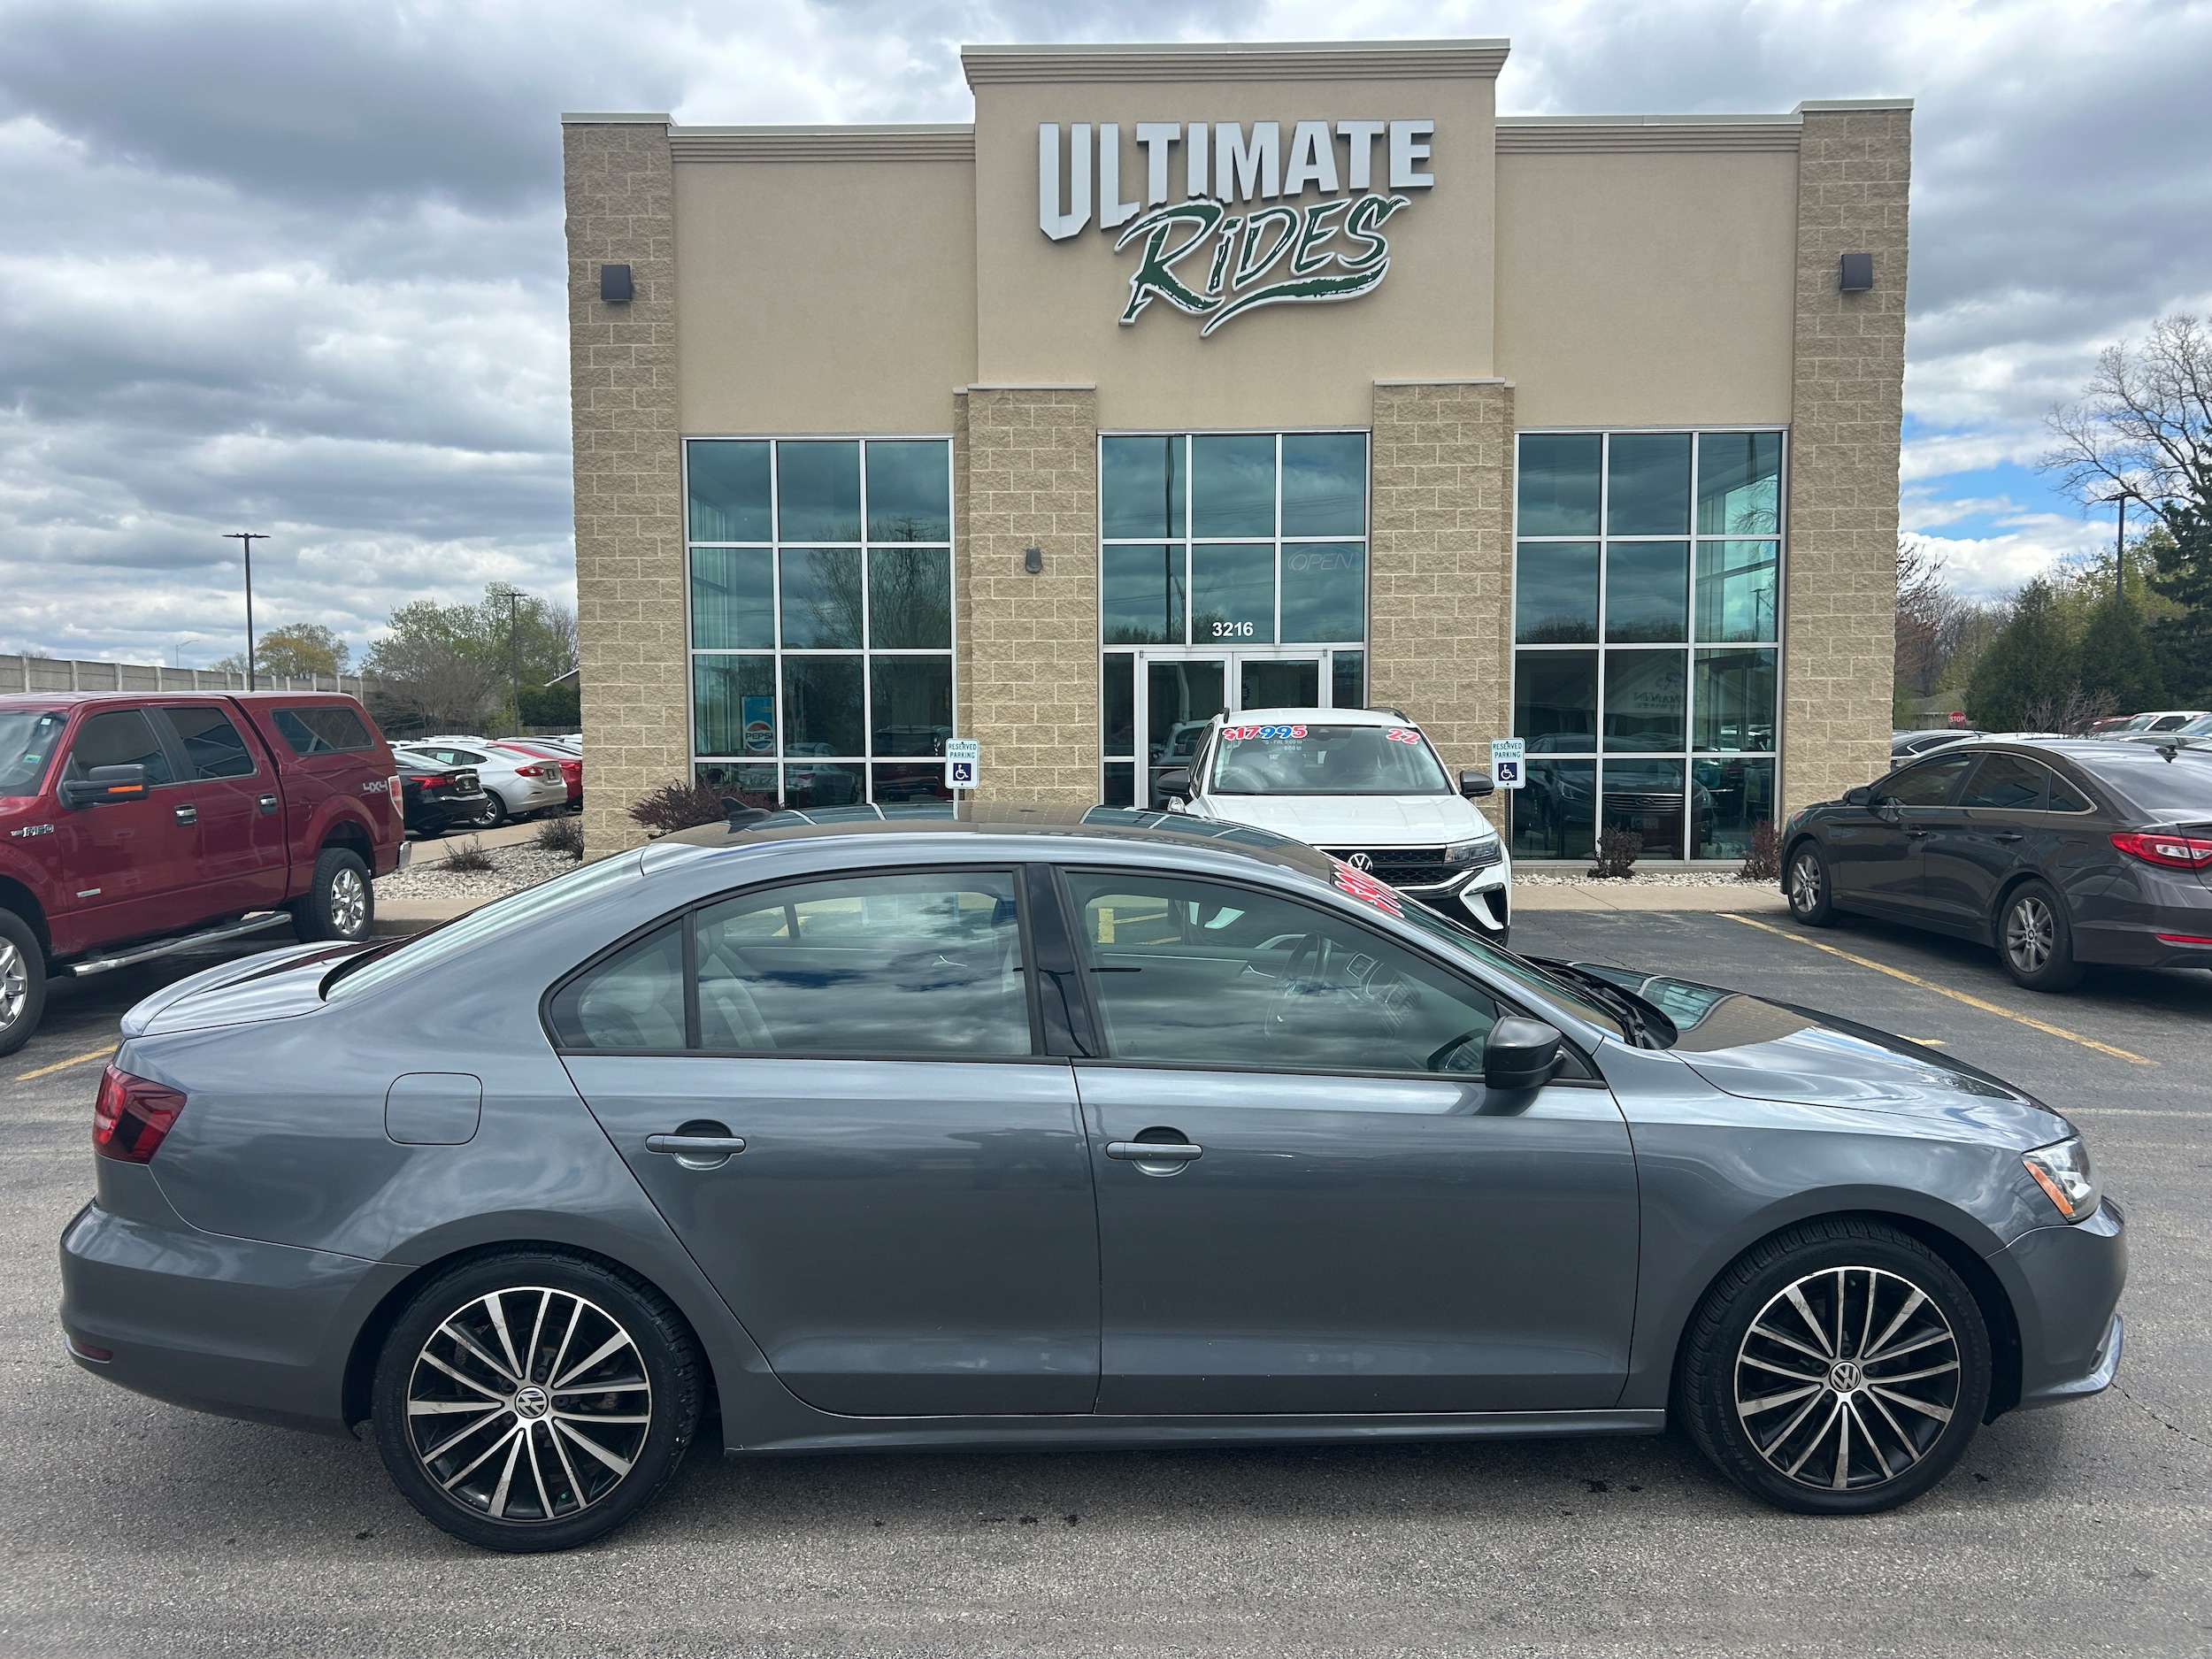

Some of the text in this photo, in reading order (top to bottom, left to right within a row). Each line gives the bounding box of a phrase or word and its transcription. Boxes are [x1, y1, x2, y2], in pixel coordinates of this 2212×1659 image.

[1038, 119, 1435, 242] ULTIMATE
[1291, 553, 1354, 572] OPEN
[1211, 621, 1254, 637] 3216
[1222, 725, 1308, 741] $17995
[1386, 727, 1421, 745] 22
